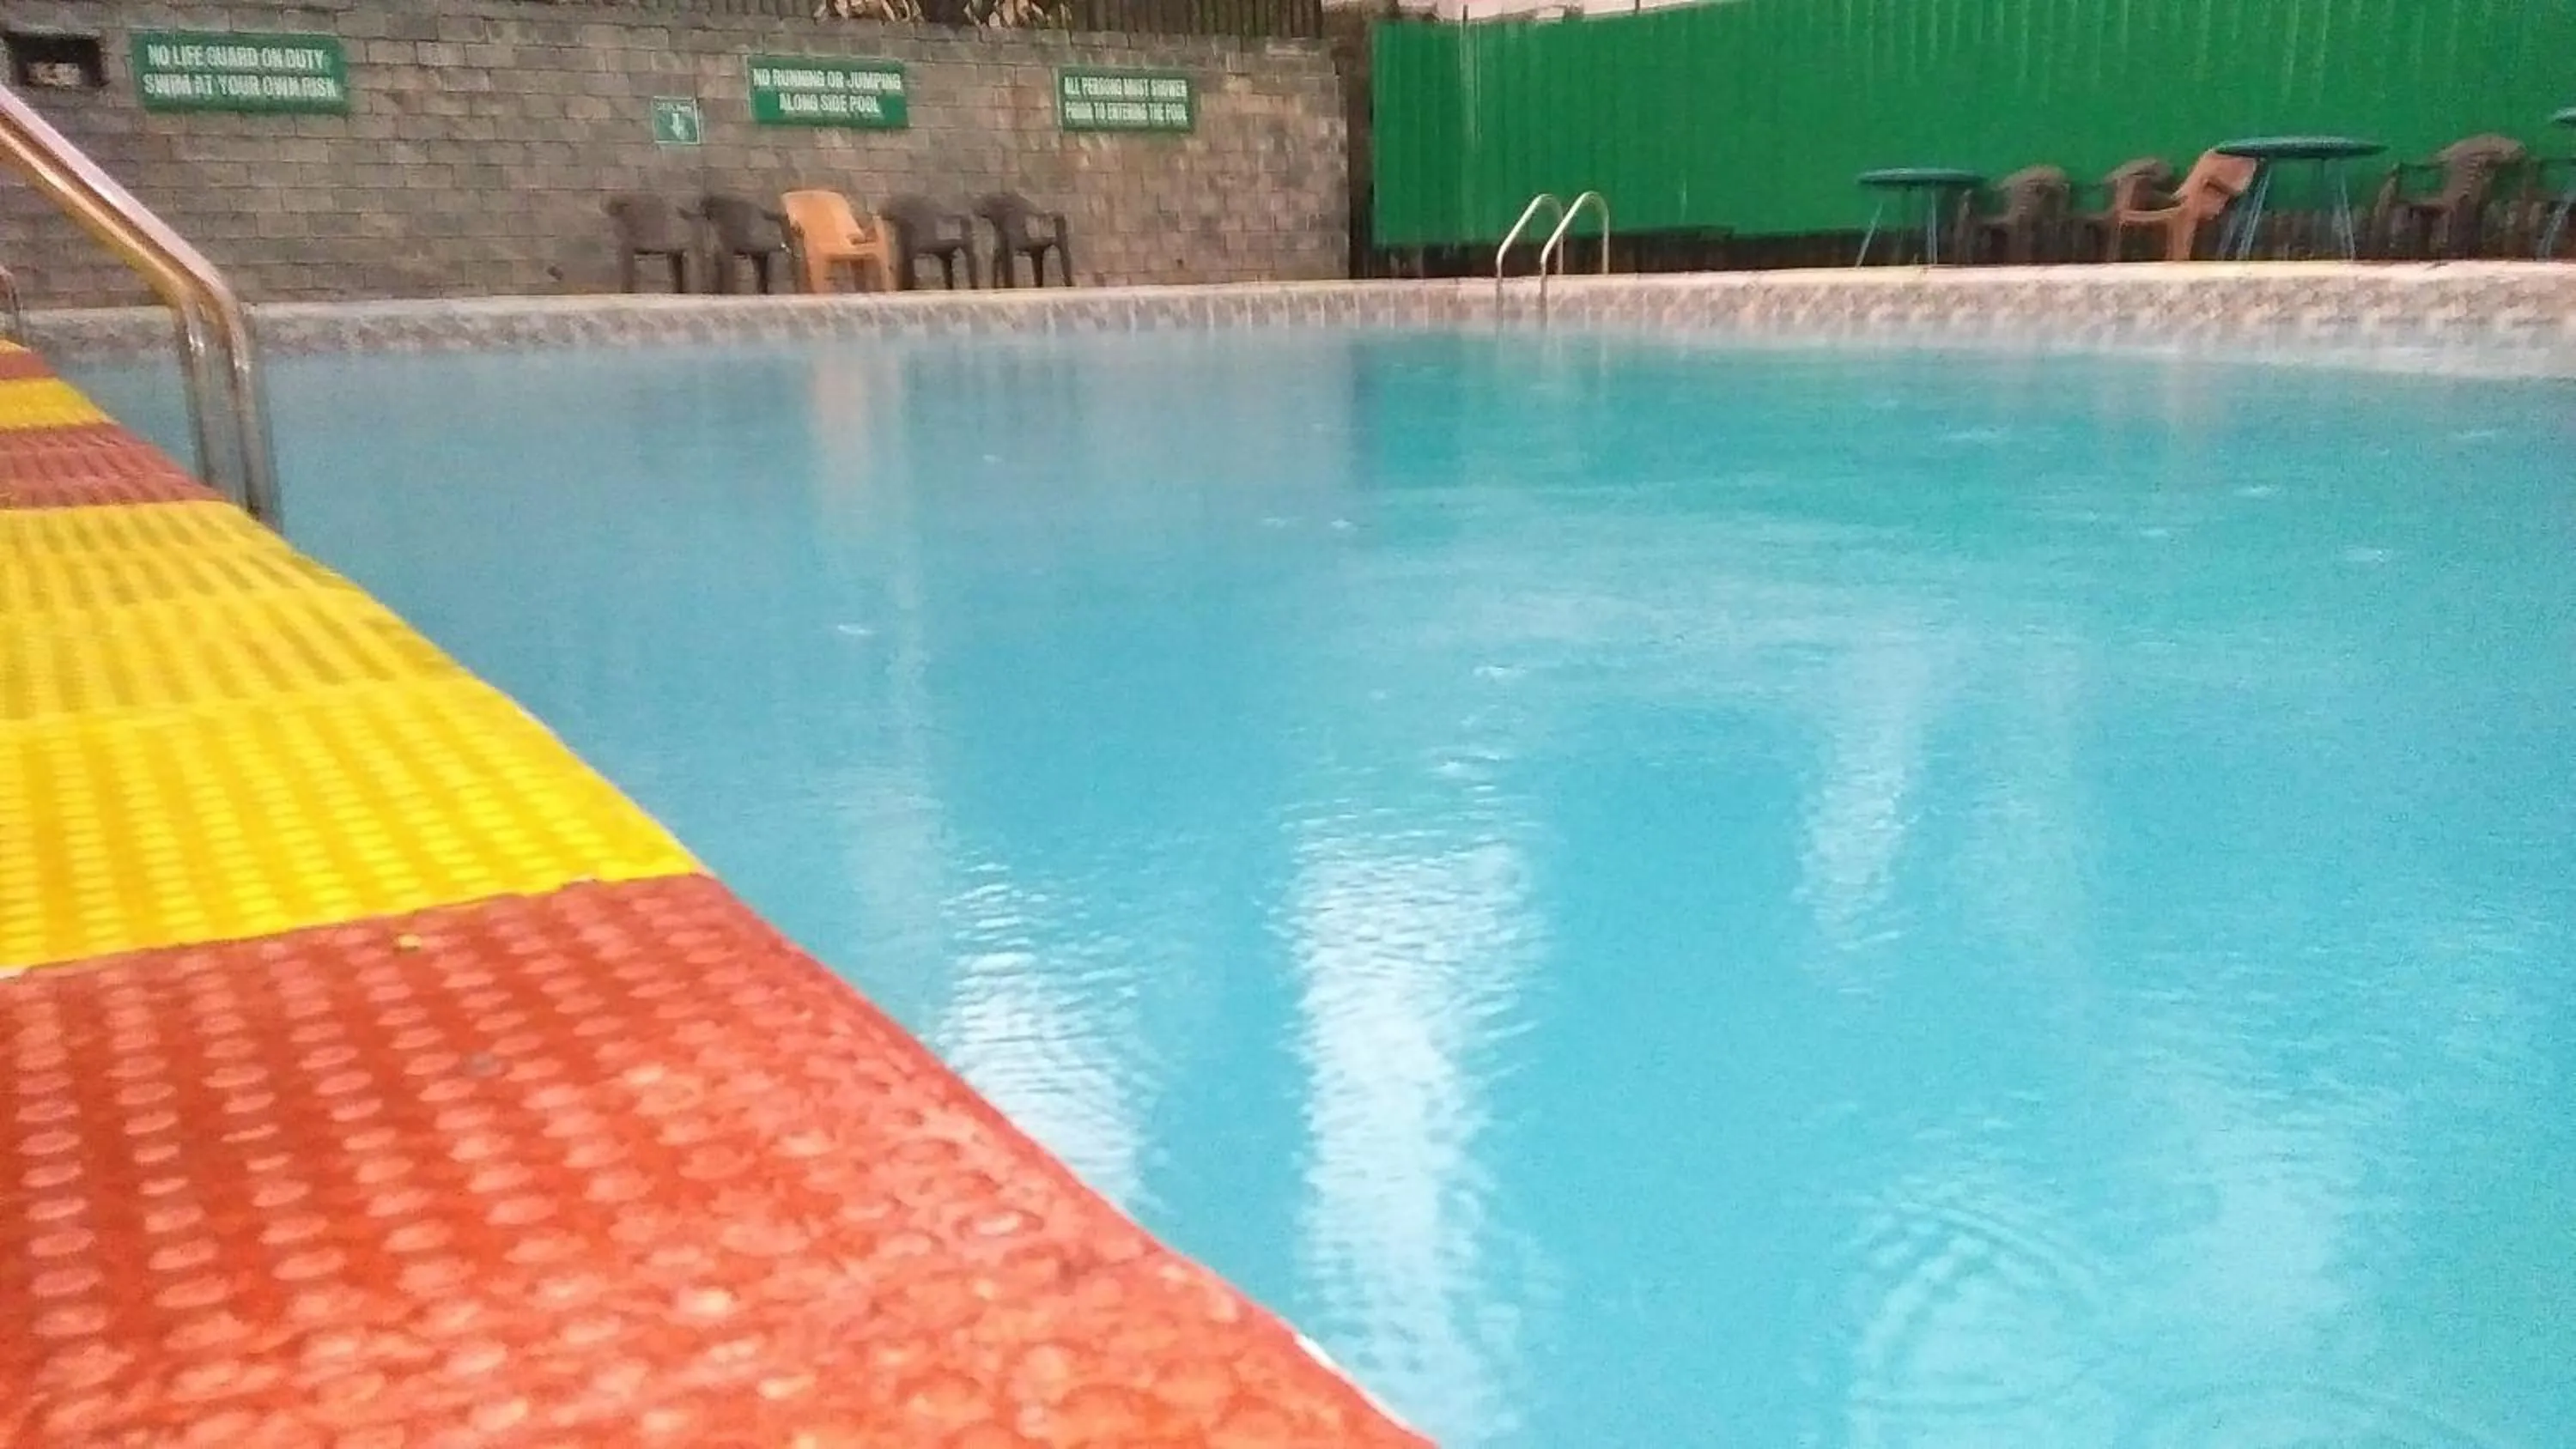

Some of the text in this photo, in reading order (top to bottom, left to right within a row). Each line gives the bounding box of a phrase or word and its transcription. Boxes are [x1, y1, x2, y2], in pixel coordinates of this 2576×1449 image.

[147, 45, 325, 70] NO LIFE GUARD ON DUTY
[143, 74, 338, 98] SWIM AT YOUR OWN RISK
[753, 69, 901, 90] NO RUNNING OR JUMPING
[1064, 76, 1080, 96] ALL
[780, 93, 880, 113] ALONG SIDE POOL
